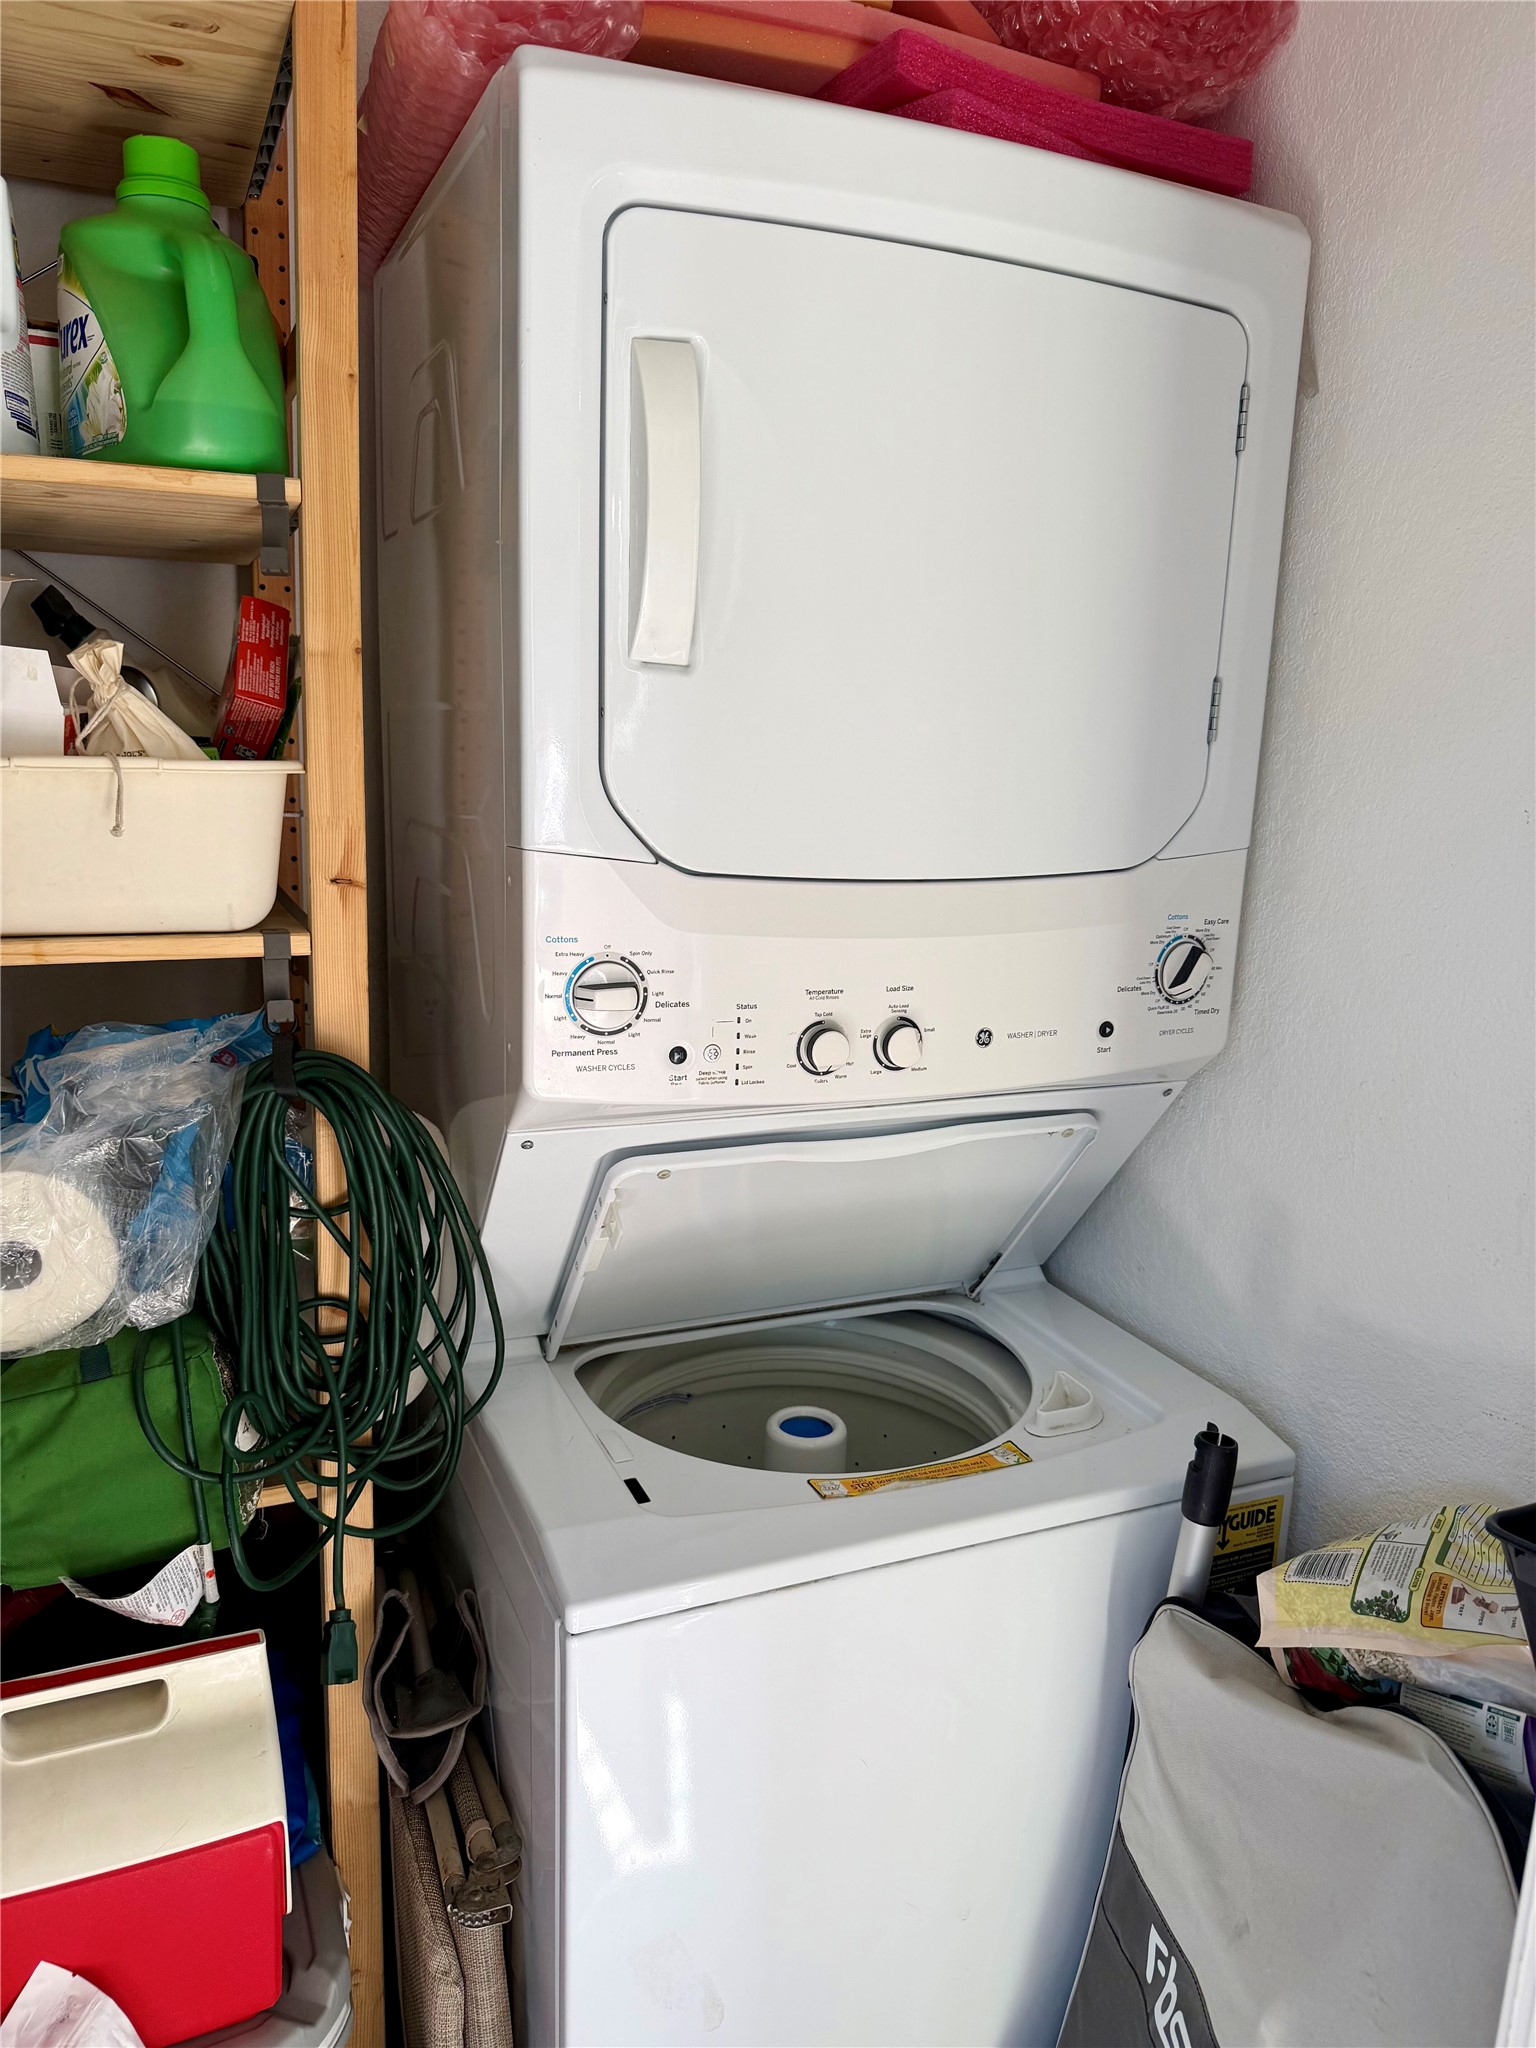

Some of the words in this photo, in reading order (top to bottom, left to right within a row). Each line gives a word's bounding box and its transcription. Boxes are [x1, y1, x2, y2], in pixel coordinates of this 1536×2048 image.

[60, 314, 89, 362] urex
[545, 936, 578, 944] Cottons
[551, 1049, 595, 1057] Permanent
[850, 1481, 874, 1489] STOP
[1222, 1505, 1277, 1532] YGUIDE
[1412, 1570, 1422, 1588] LOCATION
